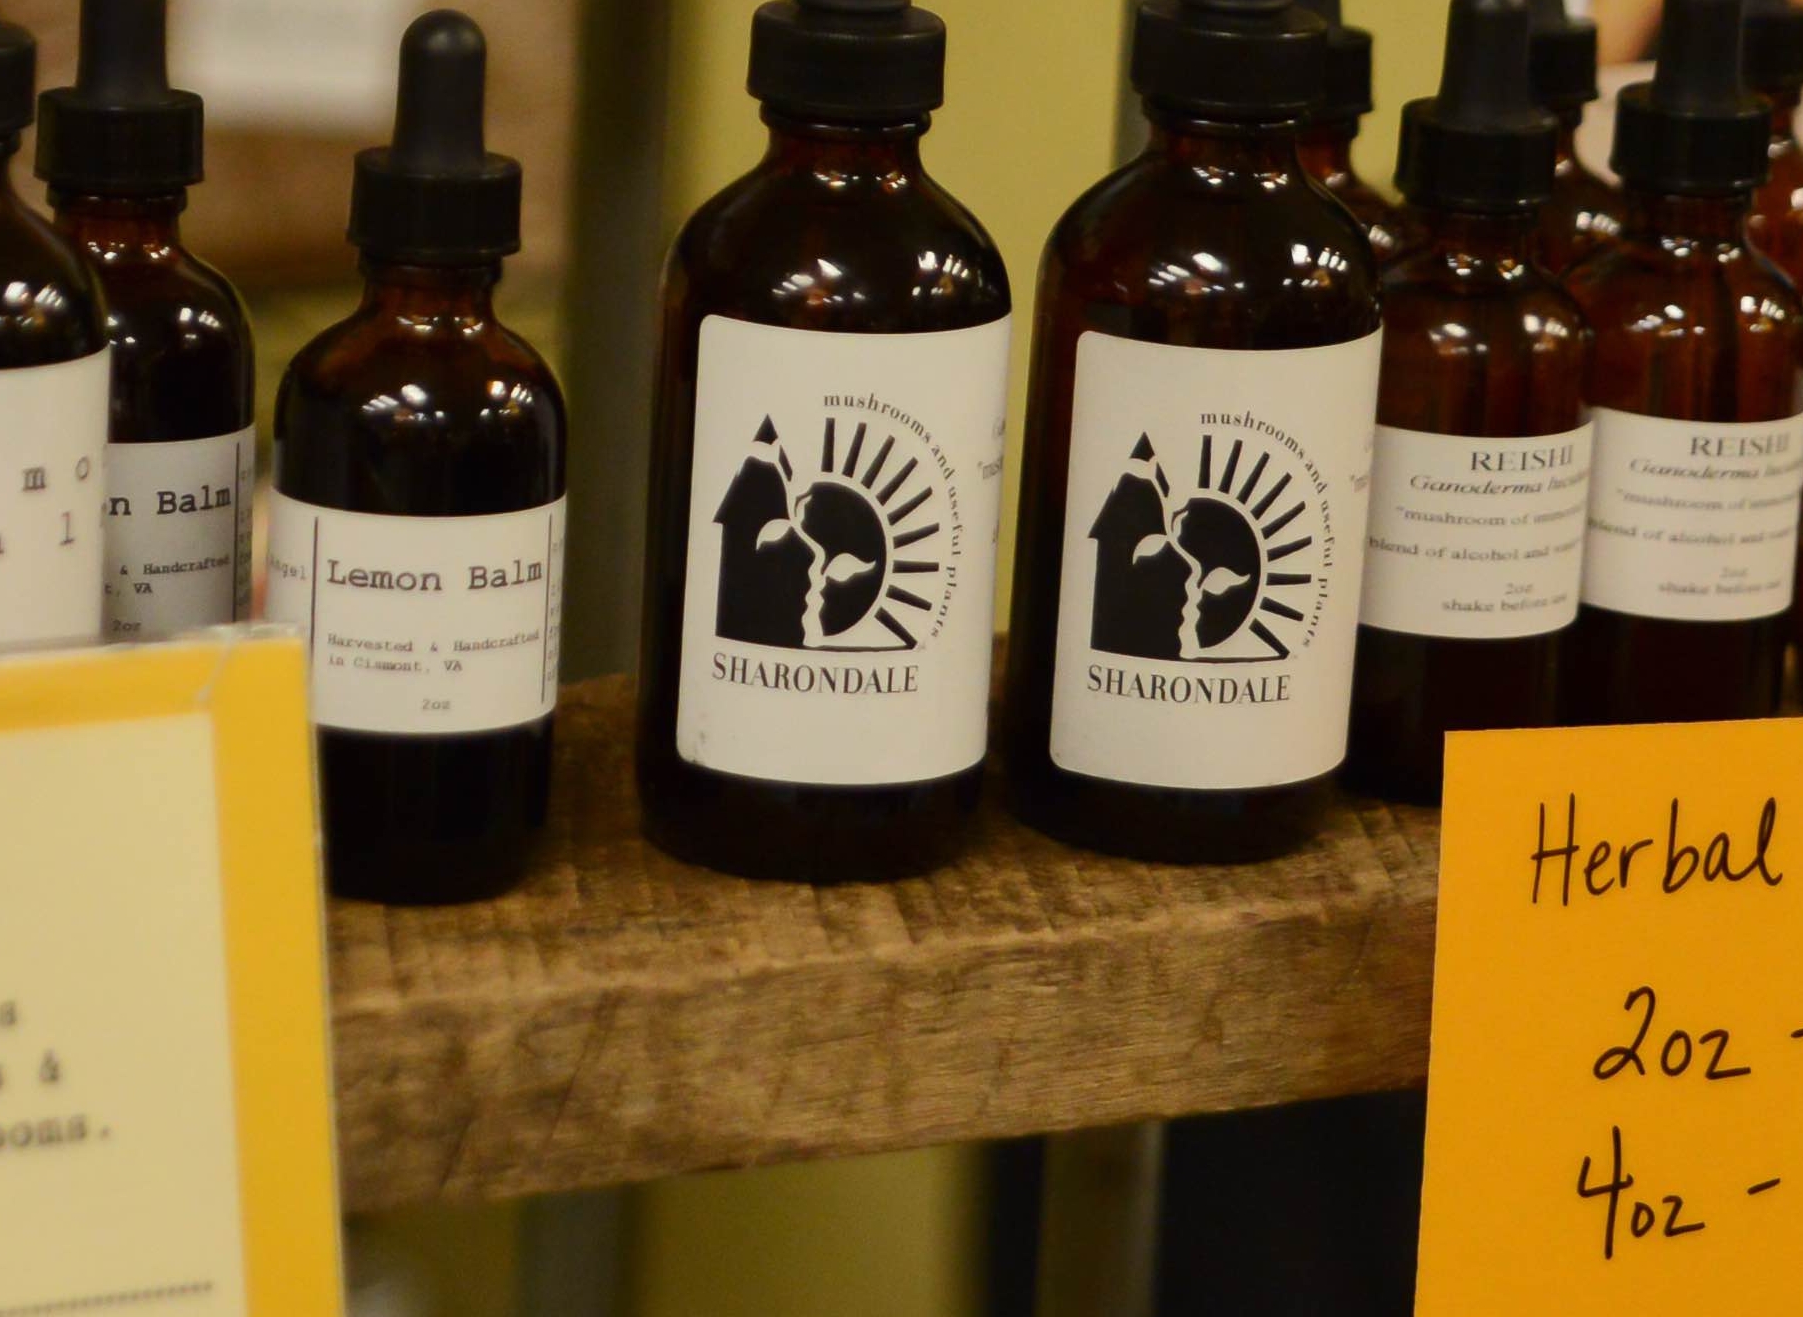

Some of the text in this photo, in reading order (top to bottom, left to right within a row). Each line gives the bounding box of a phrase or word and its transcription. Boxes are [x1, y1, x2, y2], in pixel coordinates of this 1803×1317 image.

[1470, 445, 1574, 472] REISHI
[1689, 434, 1791, 458] REISHI
[823, 392, 932, 445] mushrooms
[930, 444, 955, 481] and
[946, 485, 966, 557] useful
[1409, 474, 1543, 496] Ganoderma
[156, 484, 233, 516] Balm
[1200, 410, 1307, 459] mushrooms
[1303, 458, 1329, 496] and
[1317, 499, 1336, 569] useful
[1509, 513, 1529, 526] of
[142, 554, 230, 576] Handcrafted
[1424, 547, 1446, 559] of
[1450, 548, 1520, 562] alcohol
[327, 558, 543, 592] Lemon Balm
[134, 582, 153, 594] VA
[1440, 599, 1496, 613] shake
[112, 619, 142, 632] 2oz
[327, 633, 414, 653] Harvested
[453, 630, 541, 653] Handcrafted
[328, 655, 345, 668] in
[444, 660, 464, 672] VA
[711, 652, 920, 695] SHARONDALE
[1086, 664, 1292, 705] SHARONDALE
[421, 698, 452, 710] 2oz
[1531, 792, 1784, 907] Herbal
[1592, 987, 1752, 1081] 2oz
[37, 1047, 63, 1085] &
[1576, 1124, 1706, 1261] 4oz
